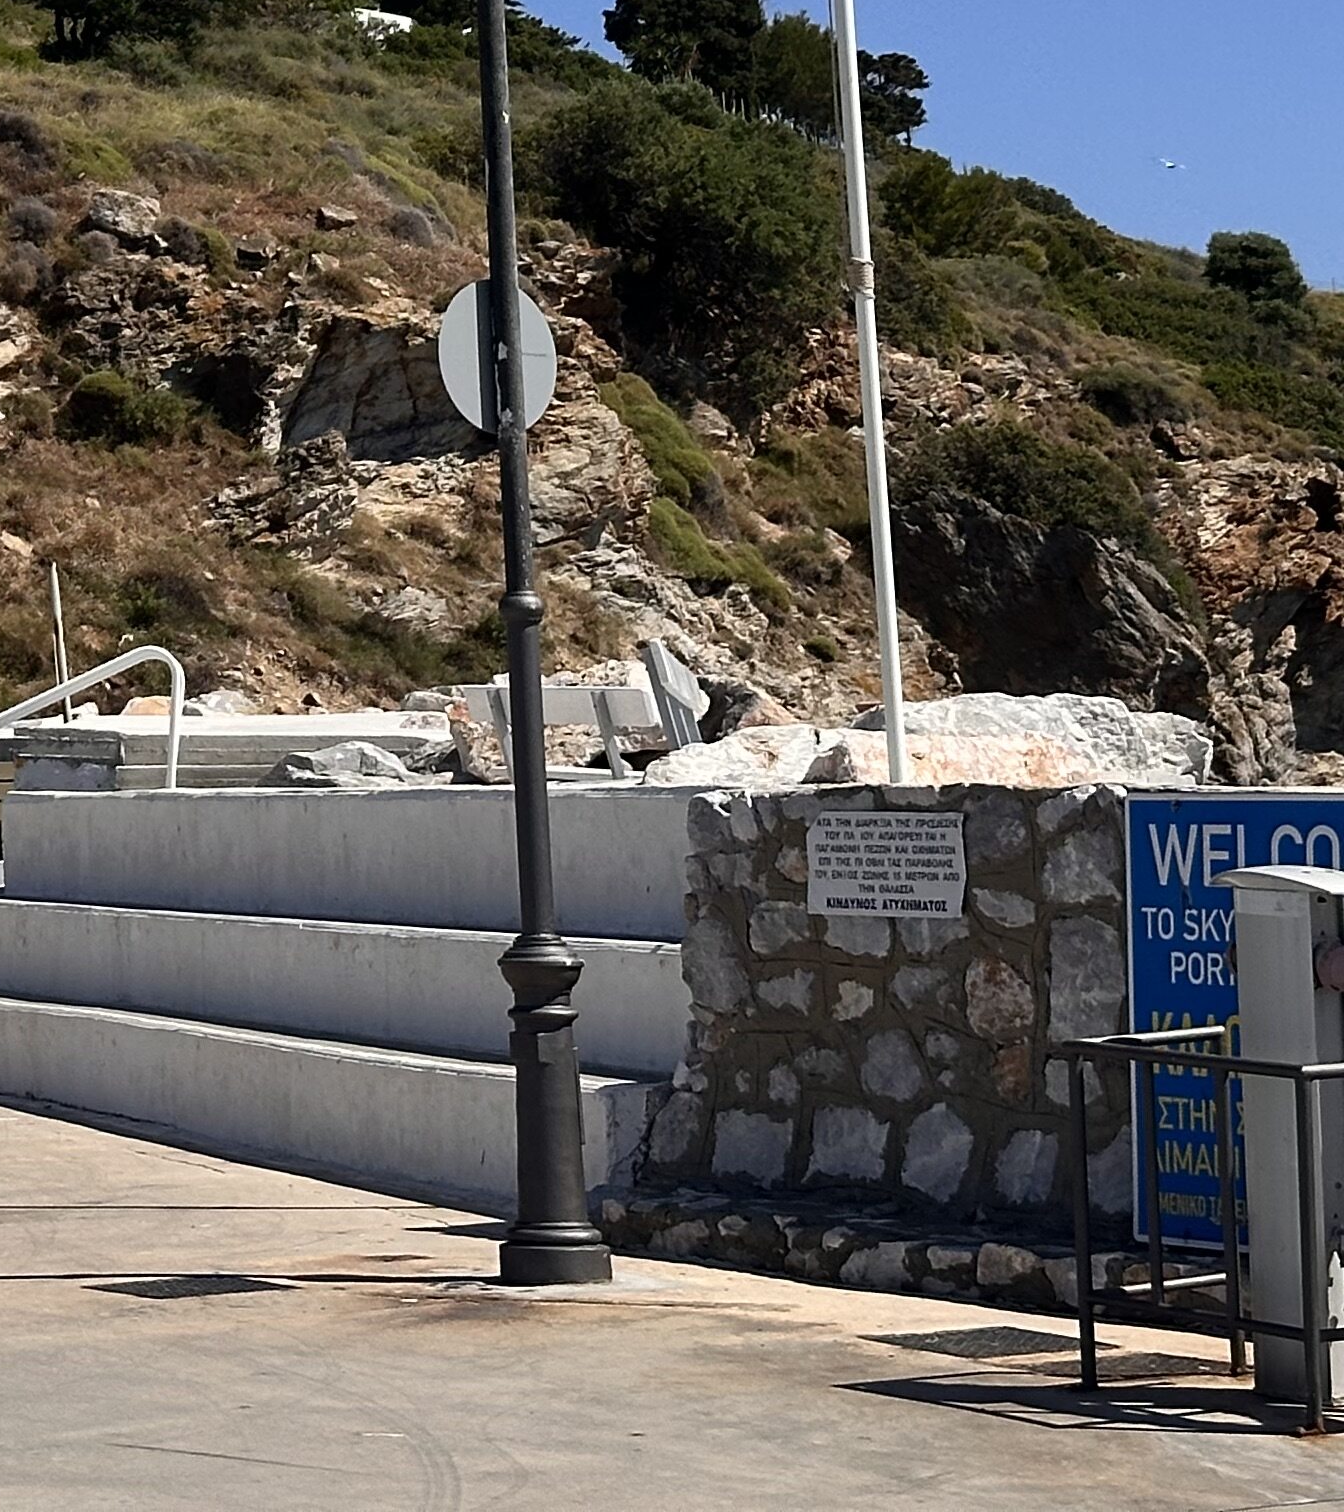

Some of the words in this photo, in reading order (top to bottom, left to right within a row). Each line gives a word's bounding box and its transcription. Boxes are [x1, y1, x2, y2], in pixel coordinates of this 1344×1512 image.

[895, 845, 909, 855] ΚΑΙ
[826, 897, 878, 910] ΚΙΝΔΥΝΟΣ
[882, 899, 948, 912] ΑΤΥΧΗΜΑΤΟΣ
[1141, 907, 1175, 940] TO
